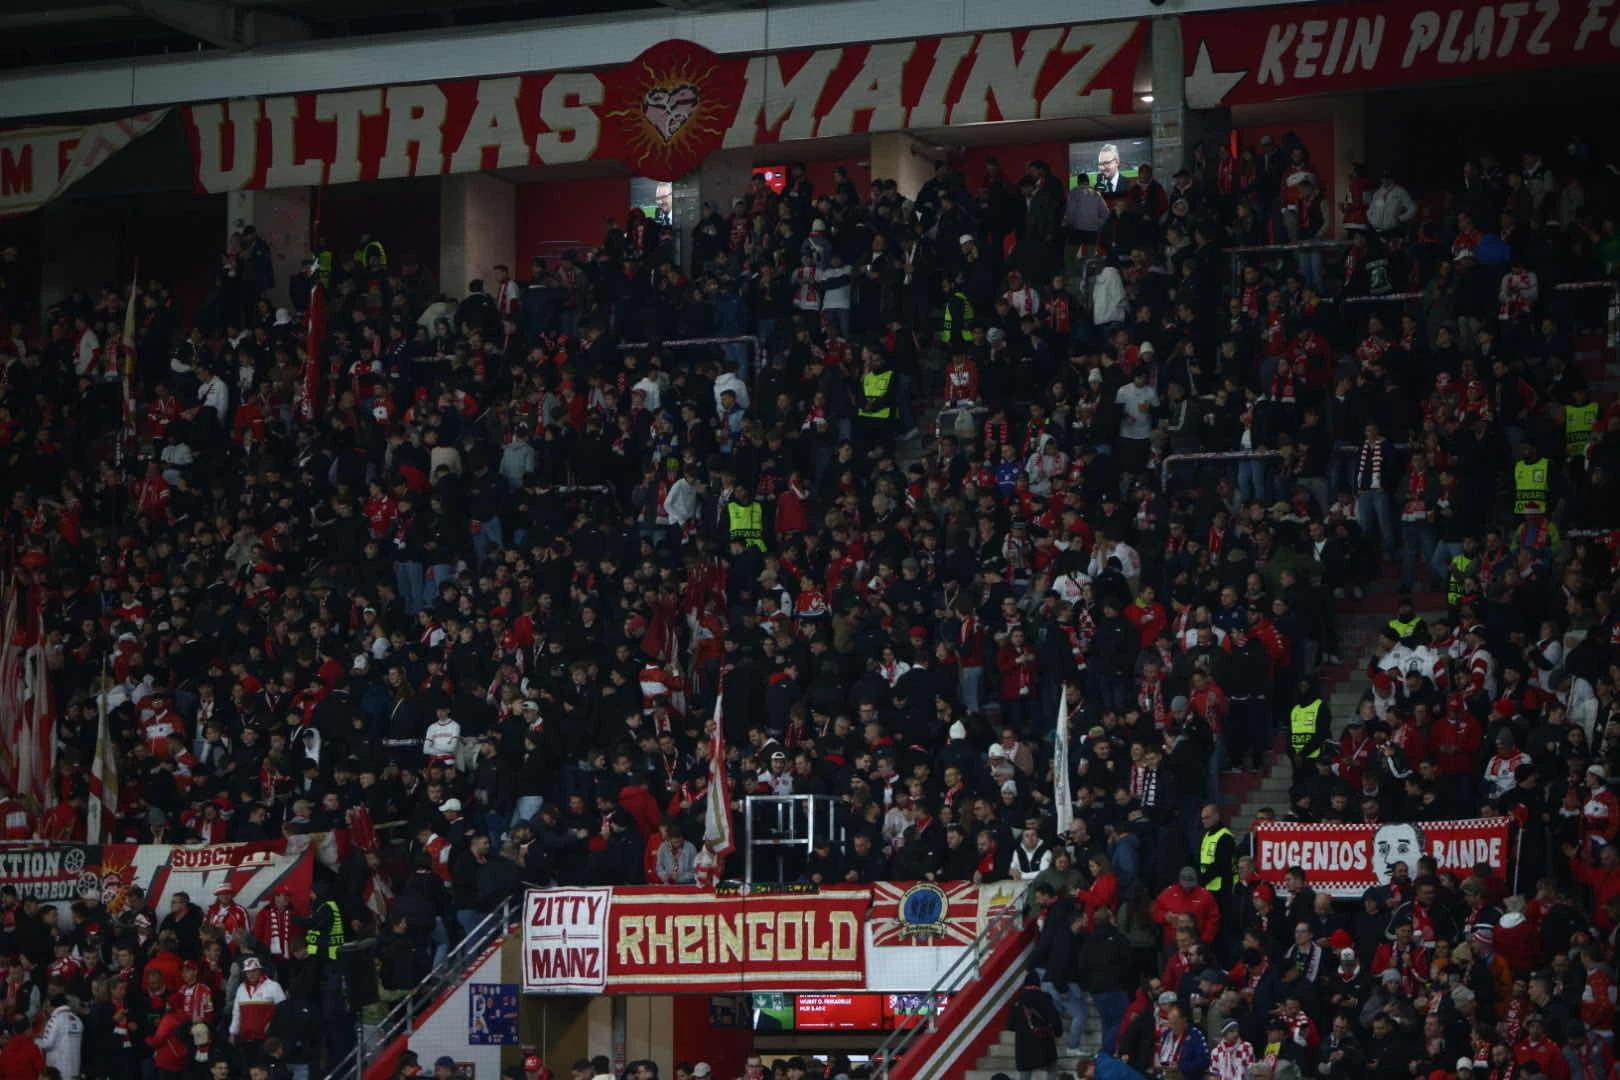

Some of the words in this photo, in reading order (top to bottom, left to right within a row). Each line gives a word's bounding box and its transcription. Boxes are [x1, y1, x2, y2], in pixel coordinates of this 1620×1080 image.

[1256, 14, 1386, 87] KEIN
[1400, 0, 1560, 69] PLATZ
[191, 71, 606, 195] ULTRAS
[720, 18, 1141, 150] MAINZ
[1260, 839, 1368, 872] EUGENIOS
[1432, 837, 1502, 870] BANDE
[531, 895, 602, 927] ZITTY
[531, 946, 600, 980] MAINZ
